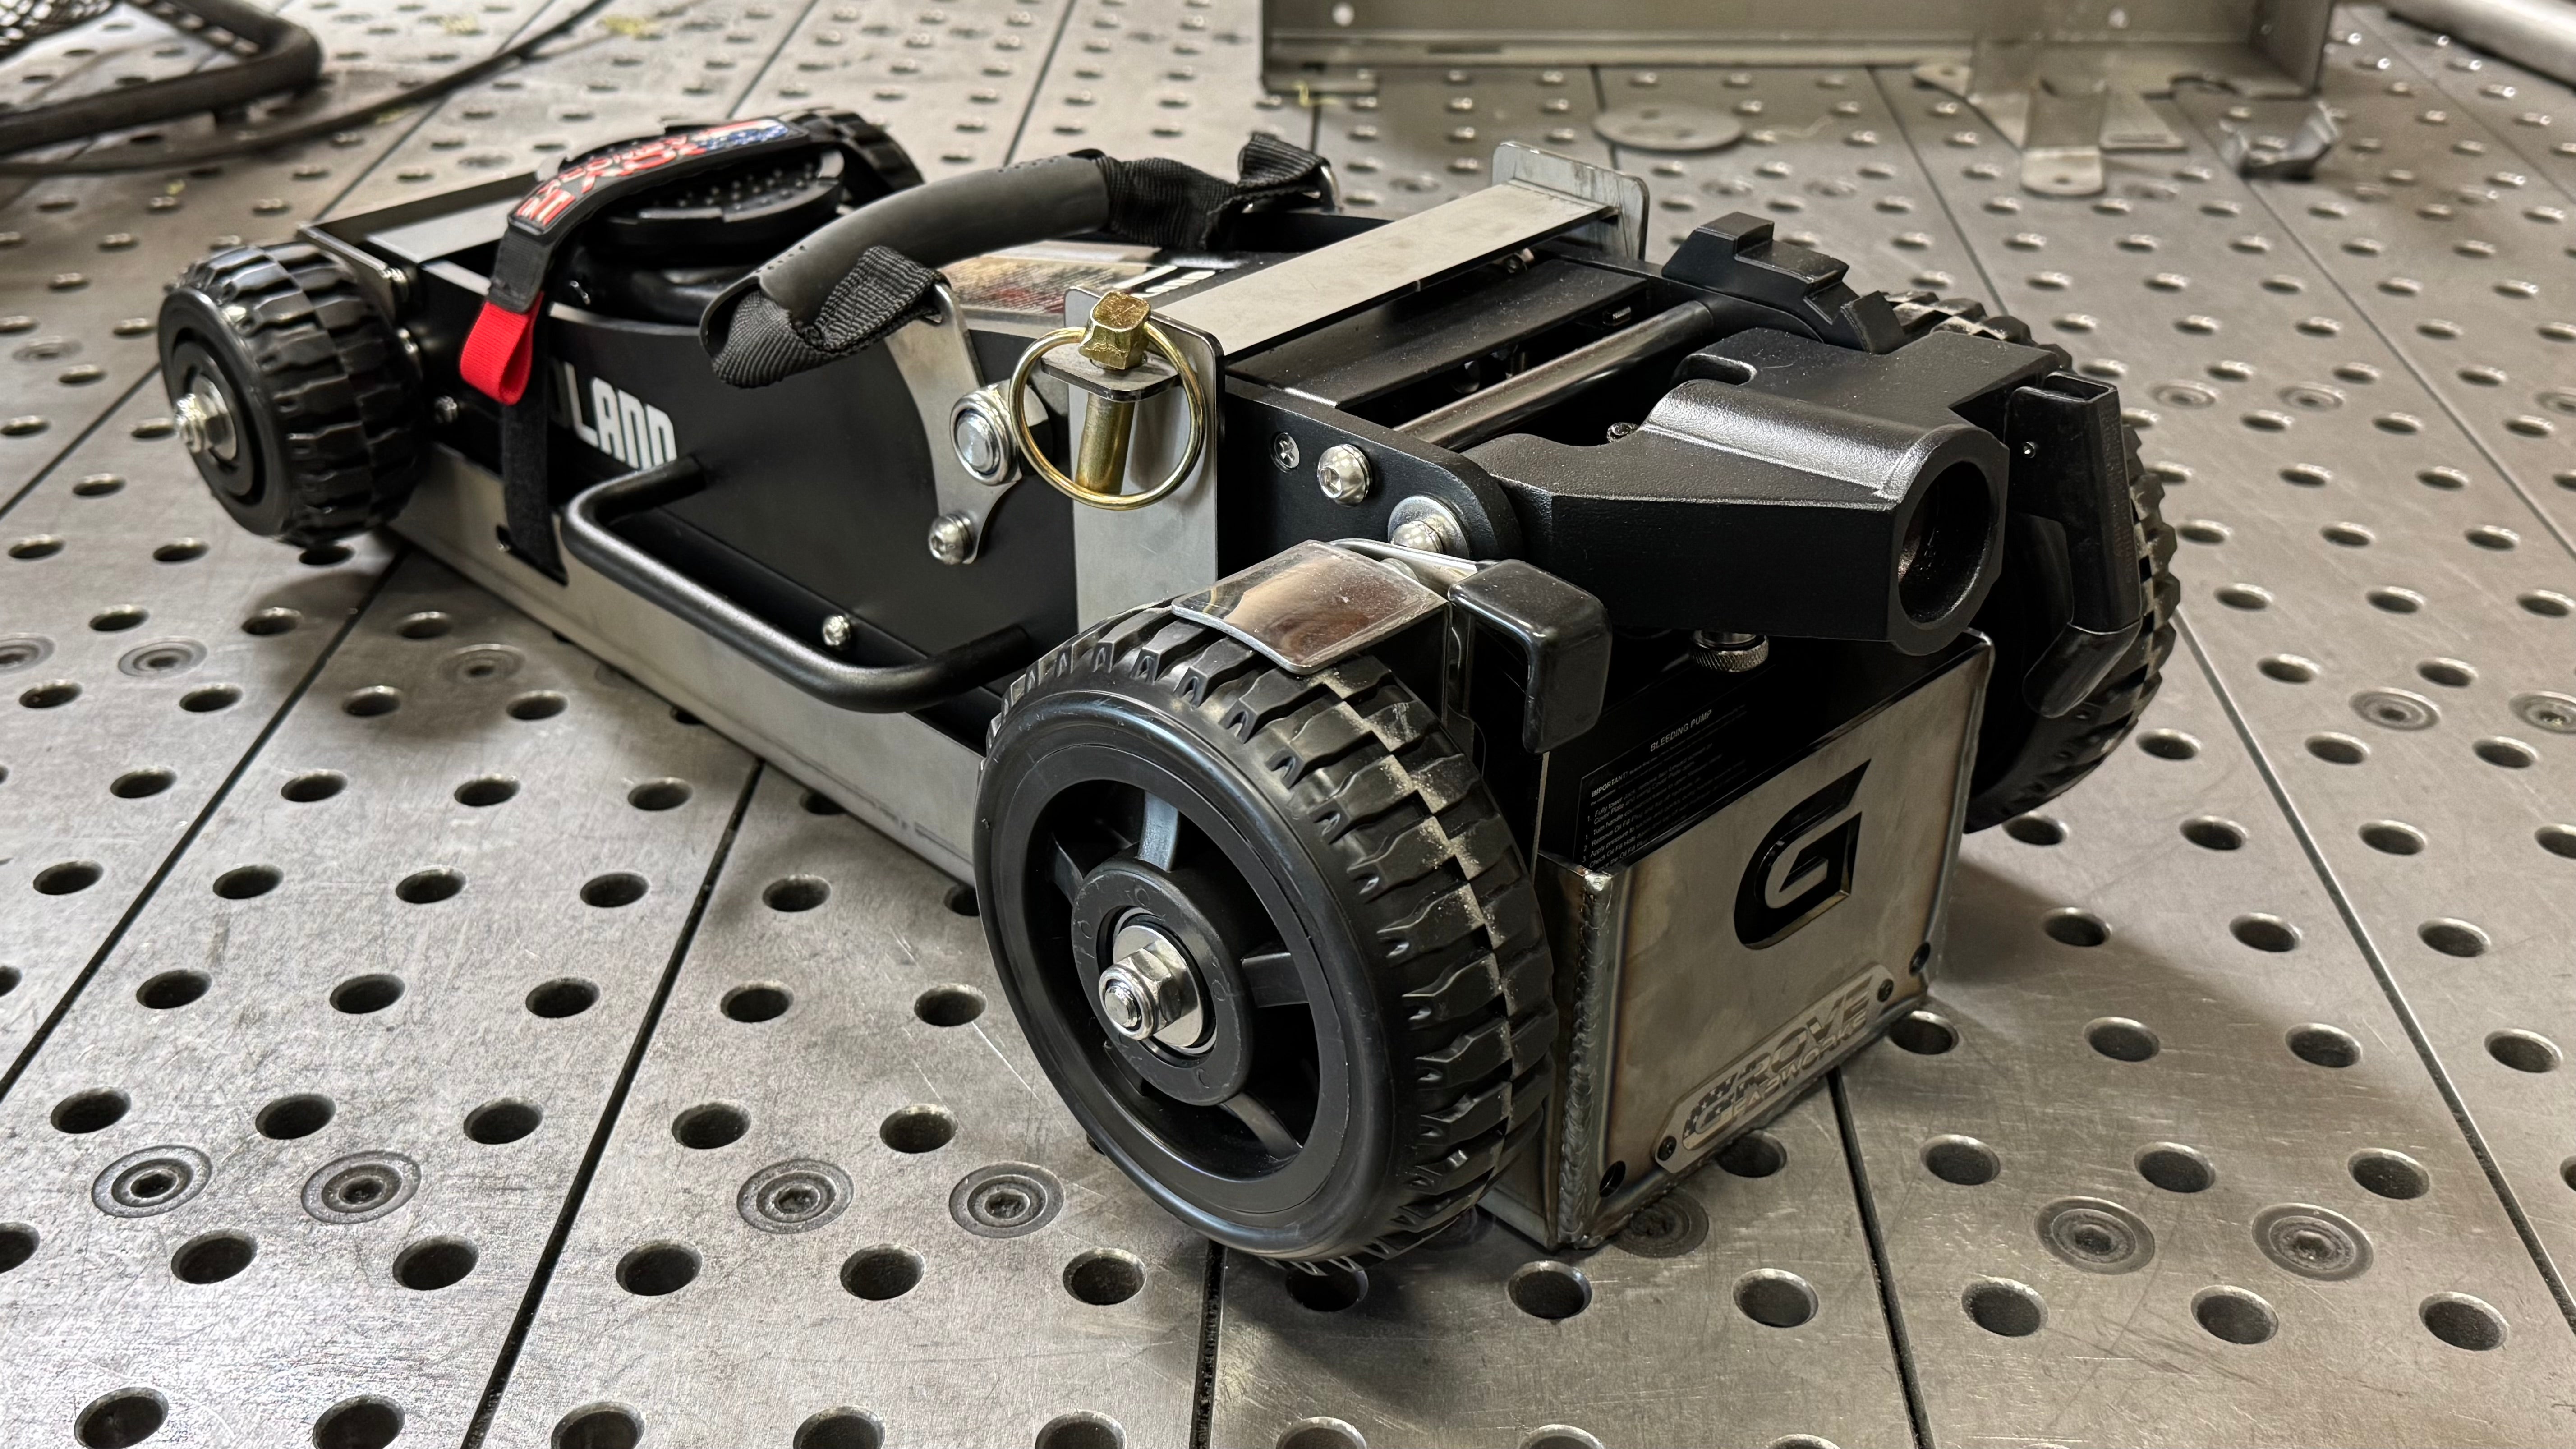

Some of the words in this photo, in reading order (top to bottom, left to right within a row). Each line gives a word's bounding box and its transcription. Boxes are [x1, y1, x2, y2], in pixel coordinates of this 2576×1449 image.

[1651, 722, 1688, 752] BLEEDING
[1690, 708, 1712, 729] PUMP
[1734, 759, 1871, 950] G
[1682, 975, 1873, 1150] GROVE
